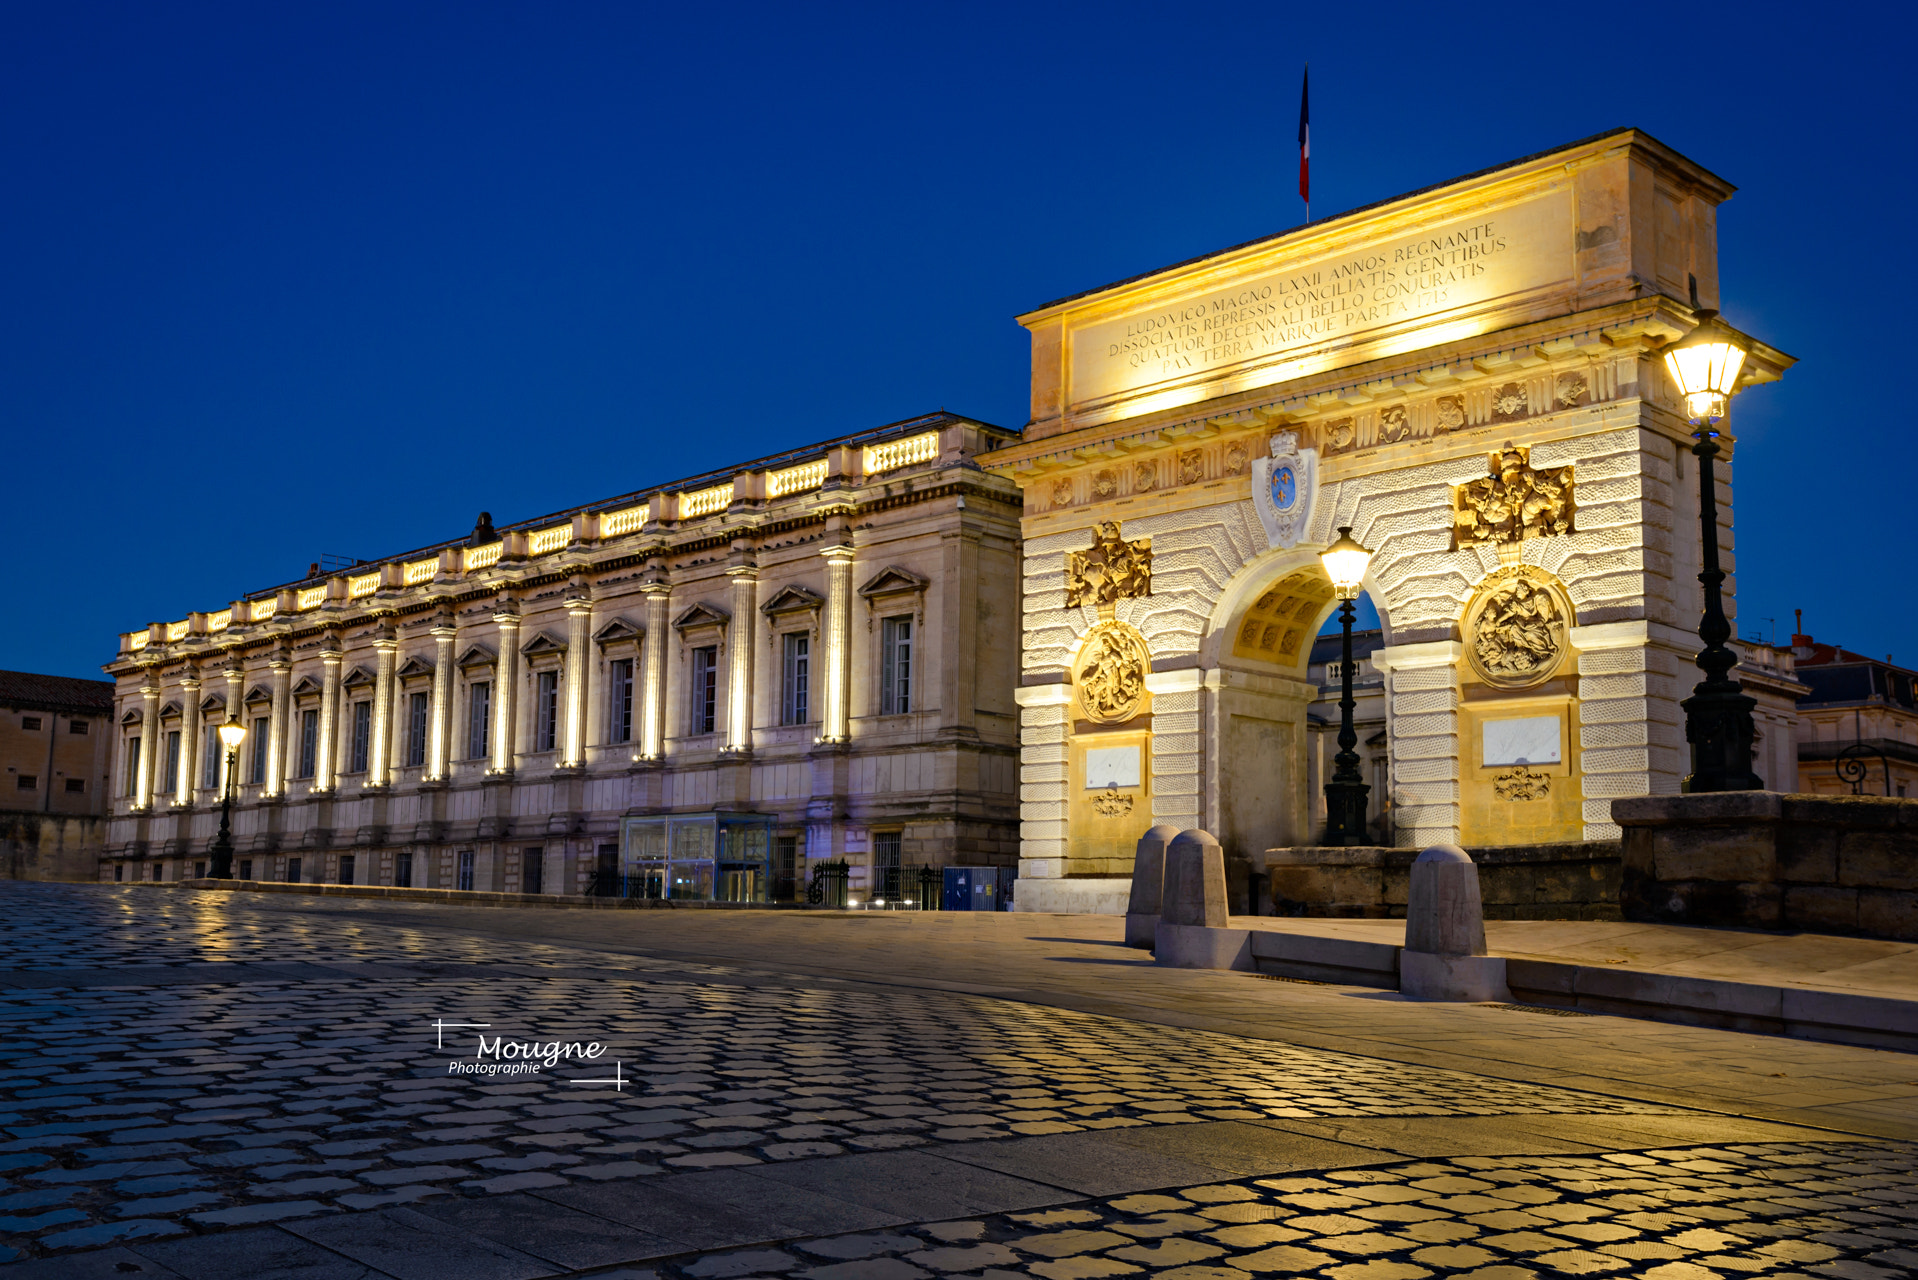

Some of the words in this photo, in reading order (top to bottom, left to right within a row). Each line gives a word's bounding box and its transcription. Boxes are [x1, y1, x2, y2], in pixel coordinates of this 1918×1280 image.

[1109, 324, 1198, 357] DISSOCIATIS
[1204, 302, 1276, 332] REPRESSIS
[1284, 267, 1396, 310] CONCILIATIS
[1405, 236, 1506, 277] GENTIBUS
[1127, 304, 1205, 337] LUDOVICO
[1212, 286, 1272, 313] MAGNO
[1279, 272, 1321, 295] LXXII
[1329, 253, 1386, 281] ANNOS
[1394, 222, 1496, 263] REGNANTE
[1129, 336, 1205, 368] QUATUOR
[1213, 309, 1304, 343] DECENNALI
[1311, 294, 1364, 319] BELLO
[1373, 260, 1485, 302] CONJURATIS
[1163, 355, 1193, 374] PAX
[1200, 340, 1254, 363] TERRA
[1262, 316, 1337, 347] MARIQUE
[1345, 301, 1408, 327] PARTA
